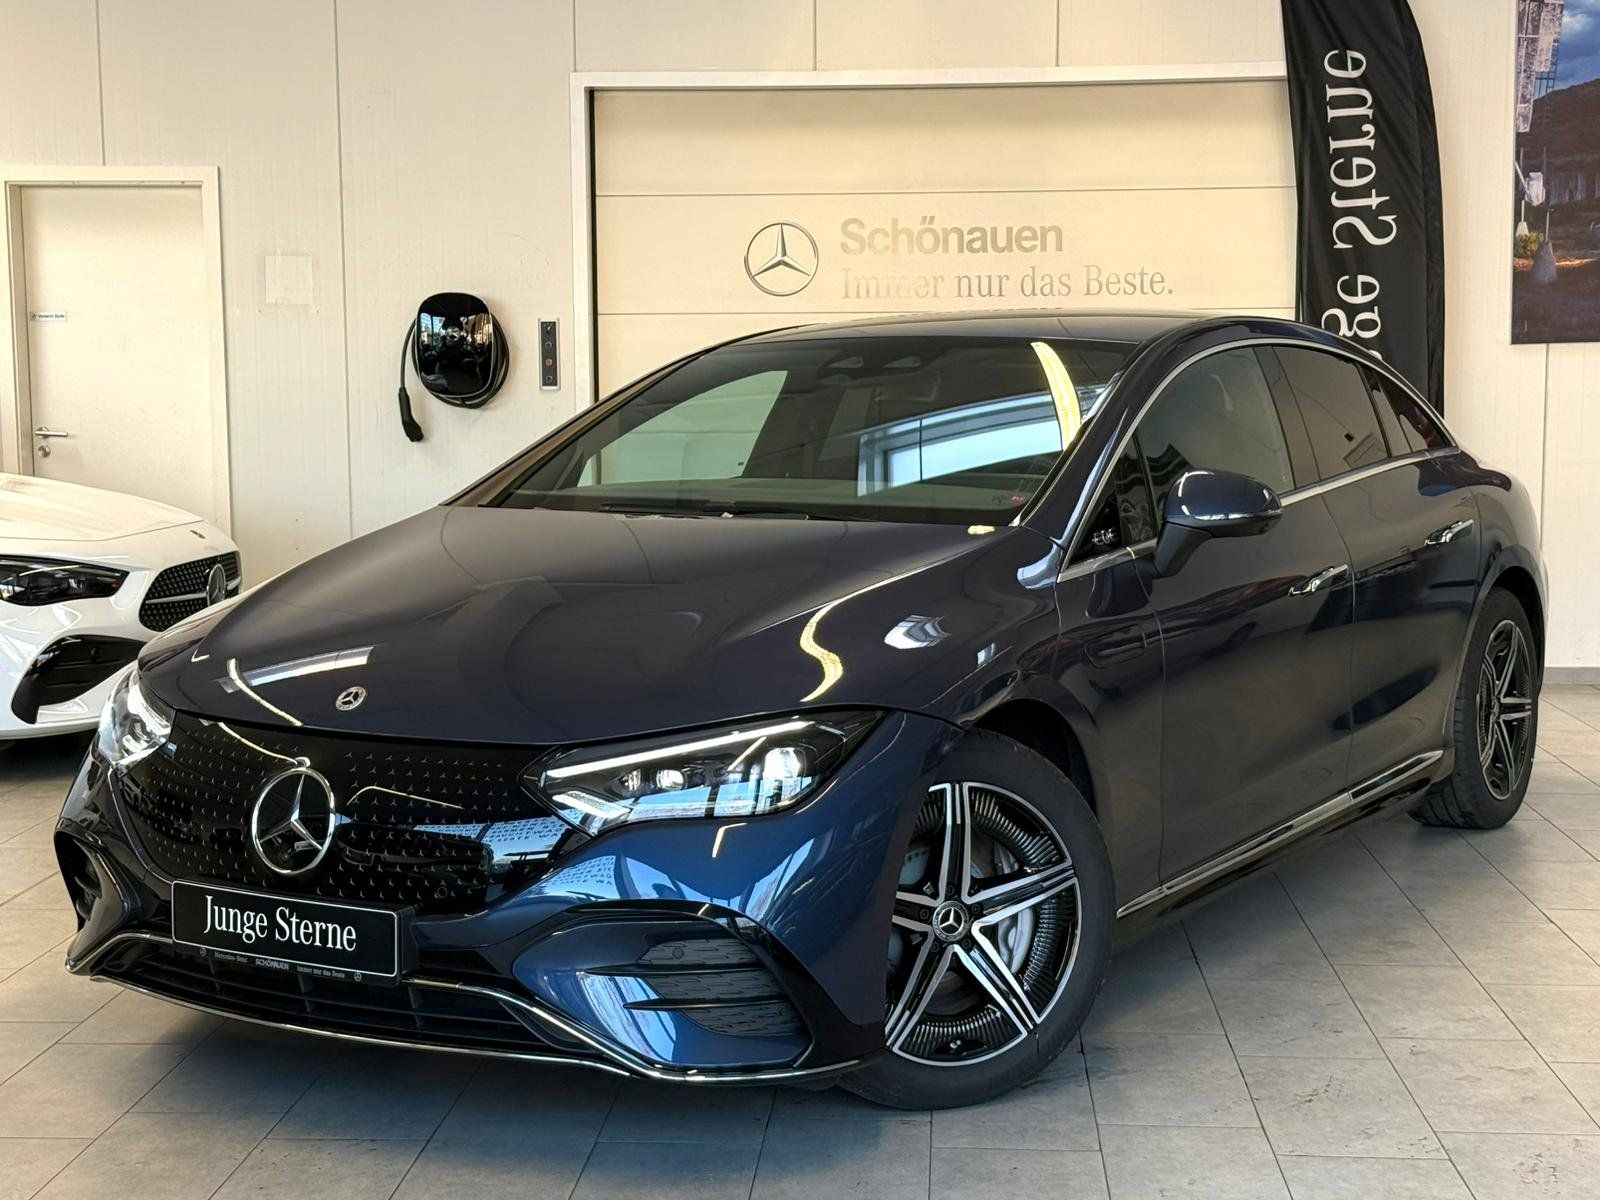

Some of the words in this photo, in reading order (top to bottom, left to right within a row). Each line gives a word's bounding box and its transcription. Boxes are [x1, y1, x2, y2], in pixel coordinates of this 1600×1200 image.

[839, 215, 1063, 256] Schönauen
[841, 267, 945, 300] Immer
[954, 274, 1010, 298] nur
[1019, 267, 1072, 298] das
[1082, 264, 1174, 297] Beste.
[203, 894, 268, 944] Junge
[274, 905, 357, 951] Sterne
